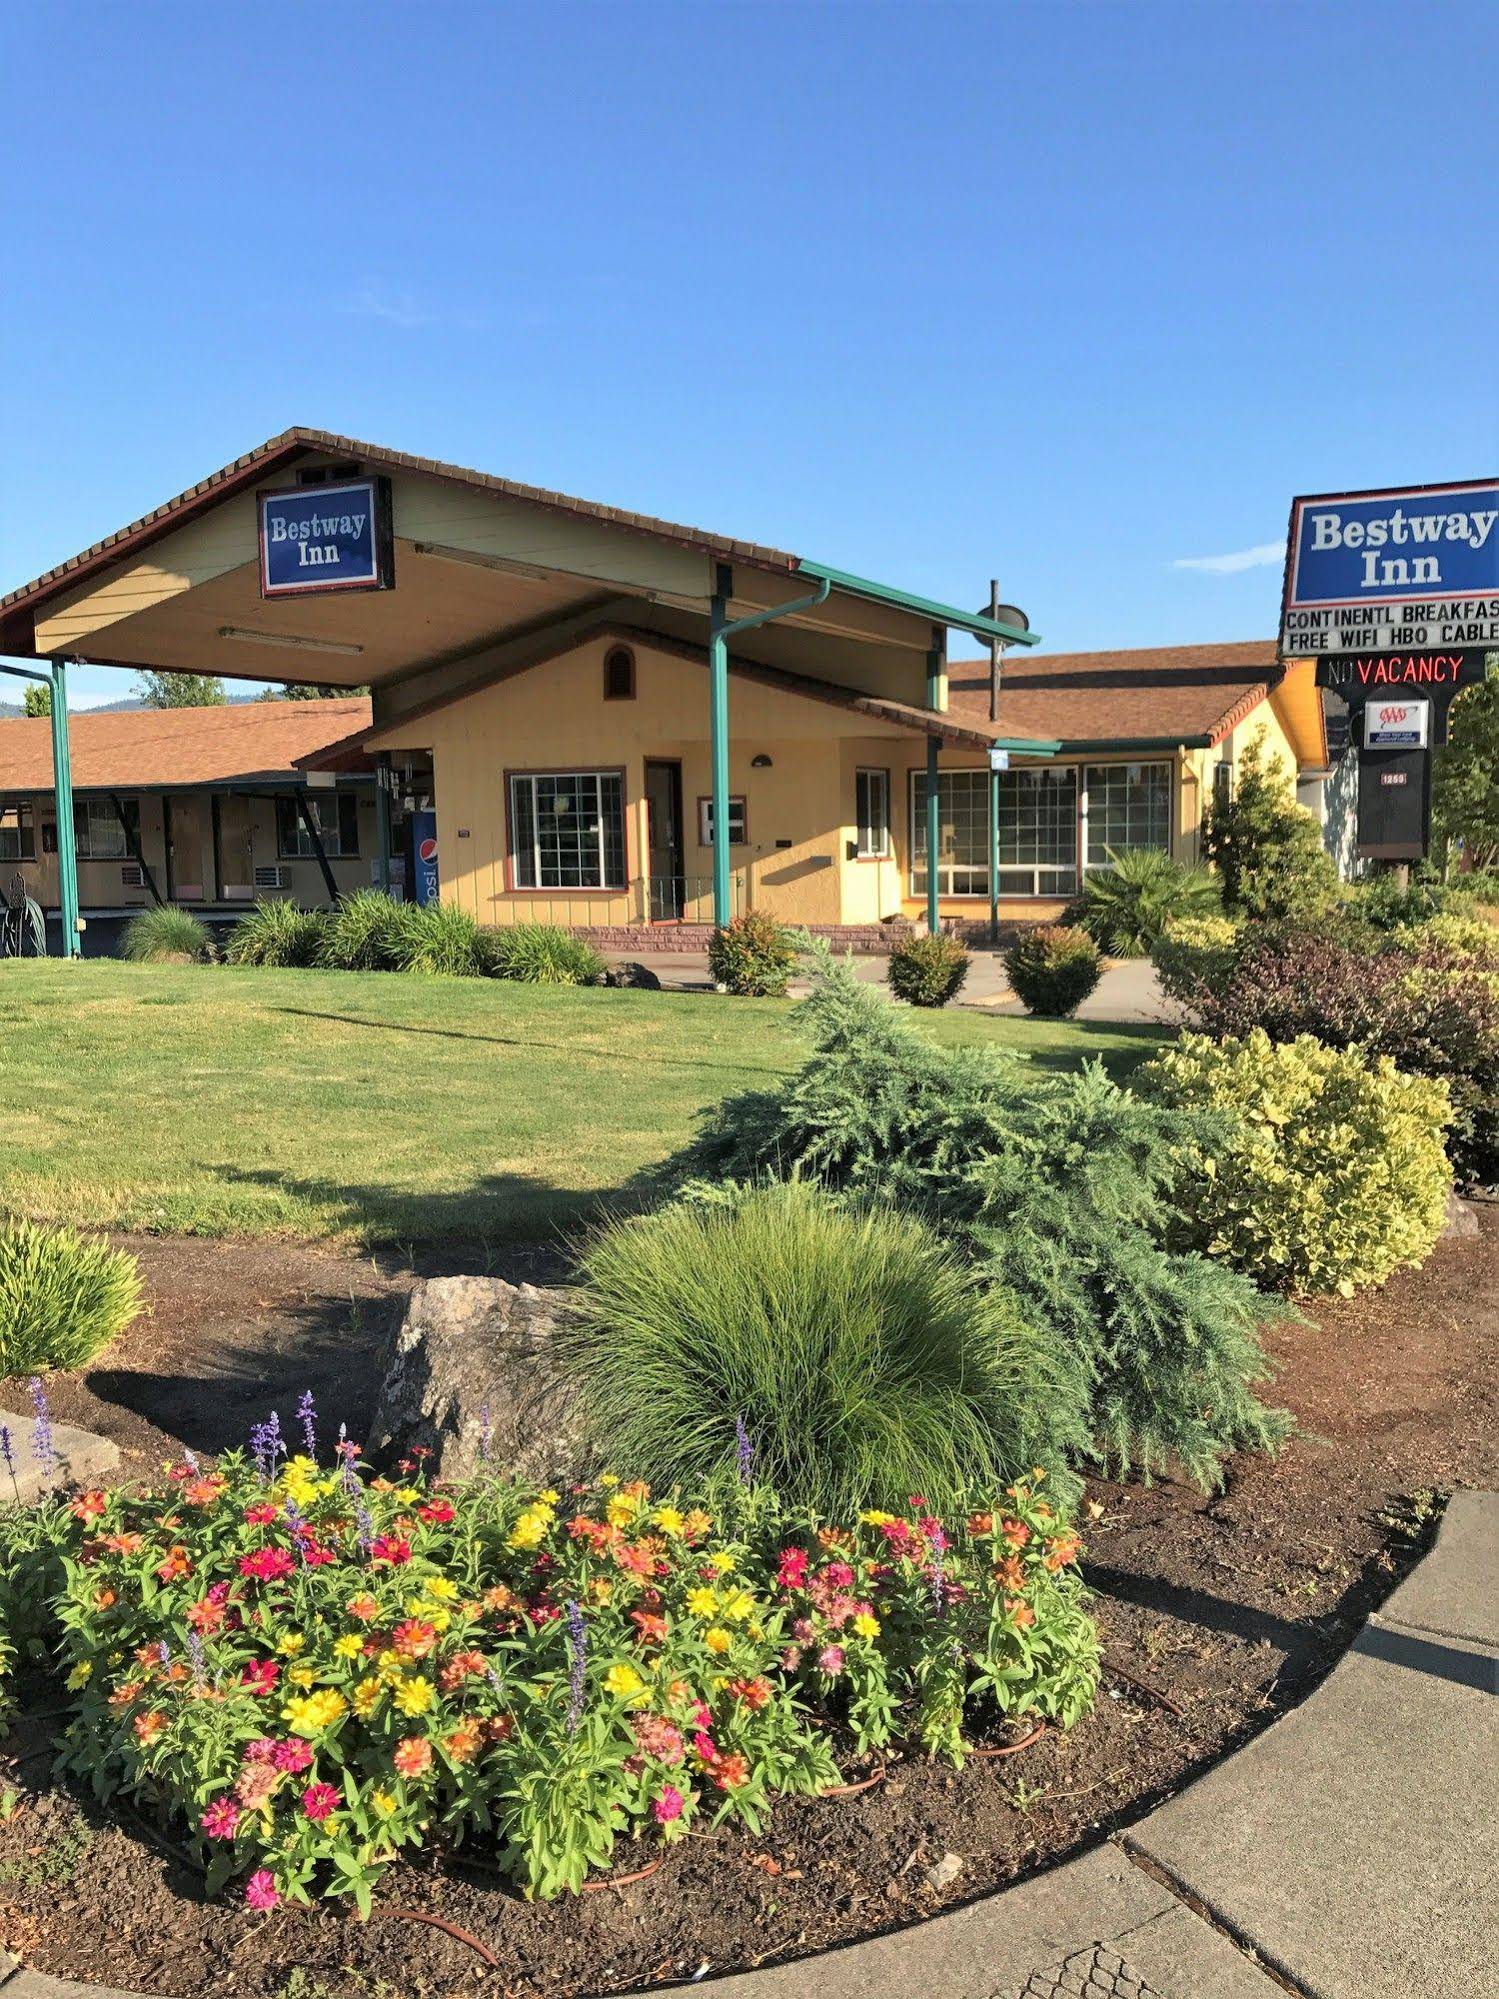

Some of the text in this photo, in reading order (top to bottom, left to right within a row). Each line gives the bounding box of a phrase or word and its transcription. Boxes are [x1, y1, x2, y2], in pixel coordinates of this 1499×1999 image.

[271, 513, 366, 542] Bestway
[1311, 508, 1499, 551] Bestway
[298, 541, 341, 567] Inn
[1360, 550, 1442, 588] Inn
[1286, 606, 1395, 630] CONTINENTL
[1289, 622, 1499, 651] FREE WIFI HBO CABLE
[1328, 655, 1464, 685] NO VACANCY
